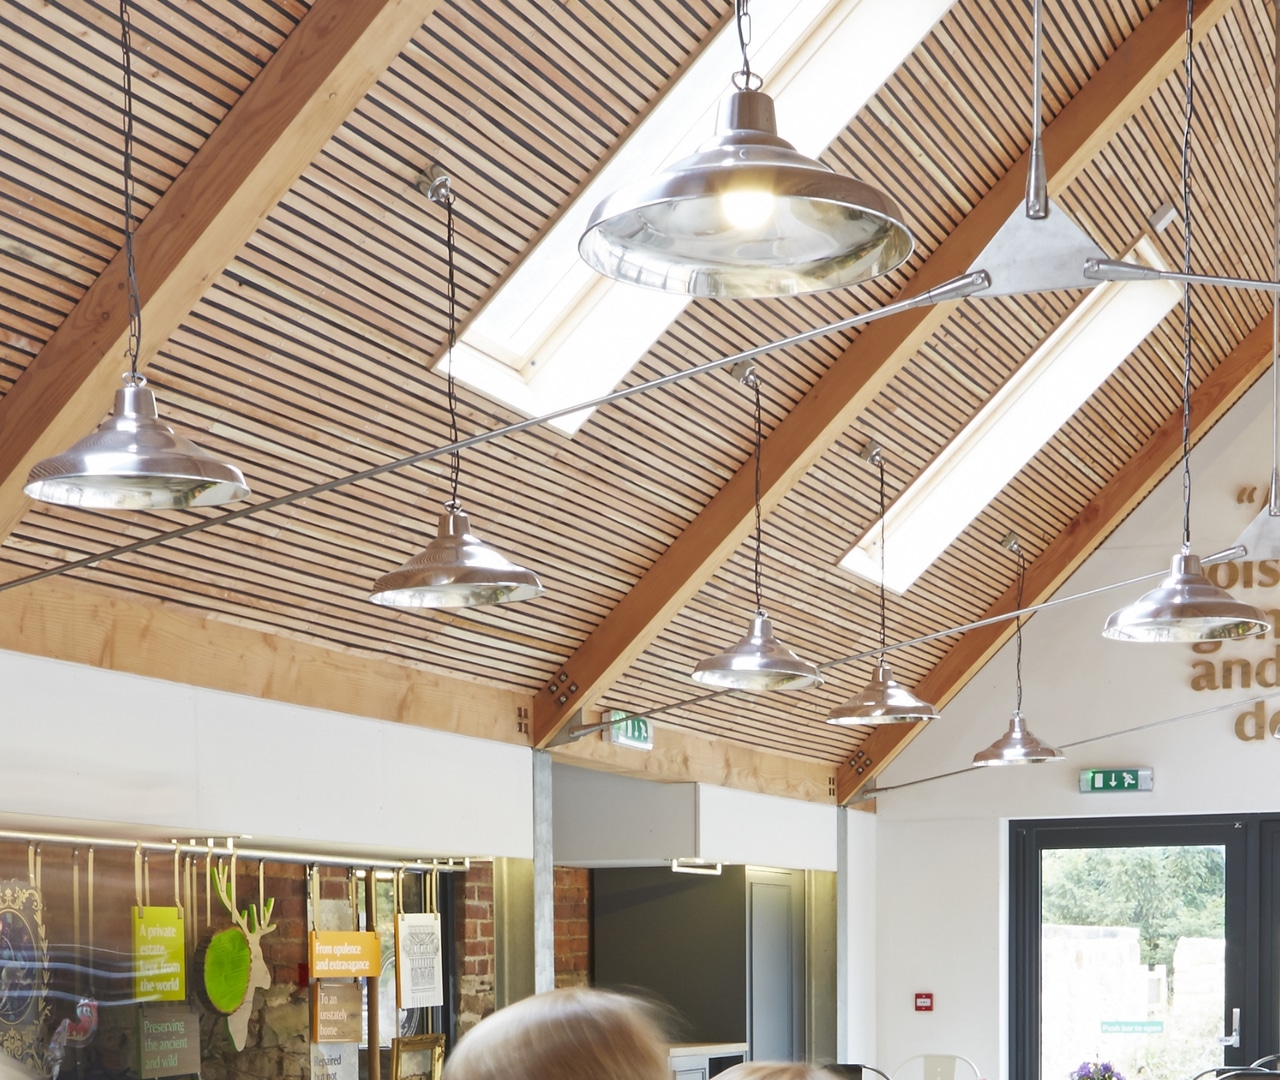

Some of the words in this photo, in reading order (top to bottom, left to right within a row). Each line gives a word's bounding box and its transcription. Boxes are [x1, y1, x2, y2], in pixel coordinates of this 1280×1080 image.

[140, 924, 146, 937] A
[148, 923, 176, 940] private
[316, 943, 332, 954] From
[333, 943, 361, 957] opulence
[140, 960, 157, 976] kept
[160, 960, 180, 973] from
[316, 959, 328, 970] and
[329, 959, 369, 973] extravagance
[141, 978, 154, 992] the
[156, 977, 179, 992] world
[320, 993, 328, 1004] To
[330, 995, 337, 1004] an
[320, 1009, 347, 1022] unstately
[144, 1019, 185, 1033] Preserving
[320, 1024, 337, 1036] home
[145, 1038, 158, 1051] the
[160, 1036, 187, 1050] ancient
[145, 1056, 160, 1069] and
[162, 1054, 178, 1068] wild
[314, 1054, 341, 1069] Repaired
[327, 1070, 337, 1080] not
